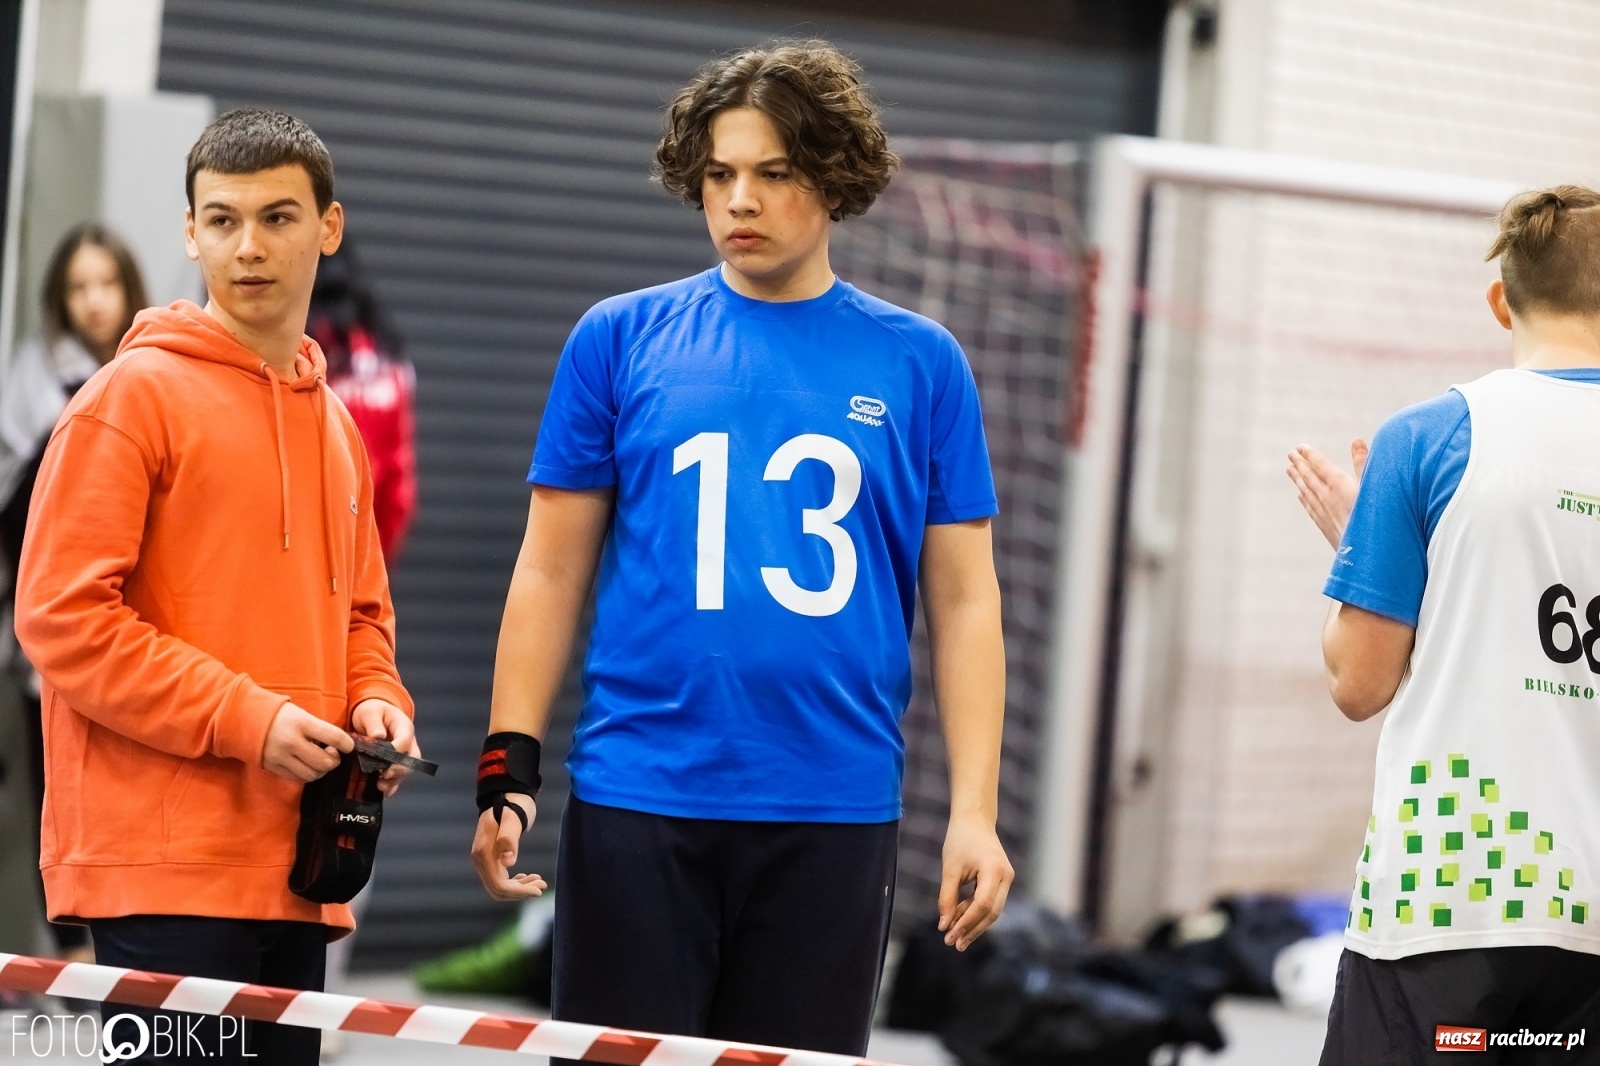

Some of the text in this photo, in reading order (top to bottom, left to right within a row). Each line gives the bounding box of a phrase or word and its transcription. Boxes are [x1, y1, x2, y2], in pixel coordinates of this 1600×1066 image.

[1557, 497, 1596, 516] JUST
[672, 432, 862, 617] 13
[340, 813, 370, 824] HMS
